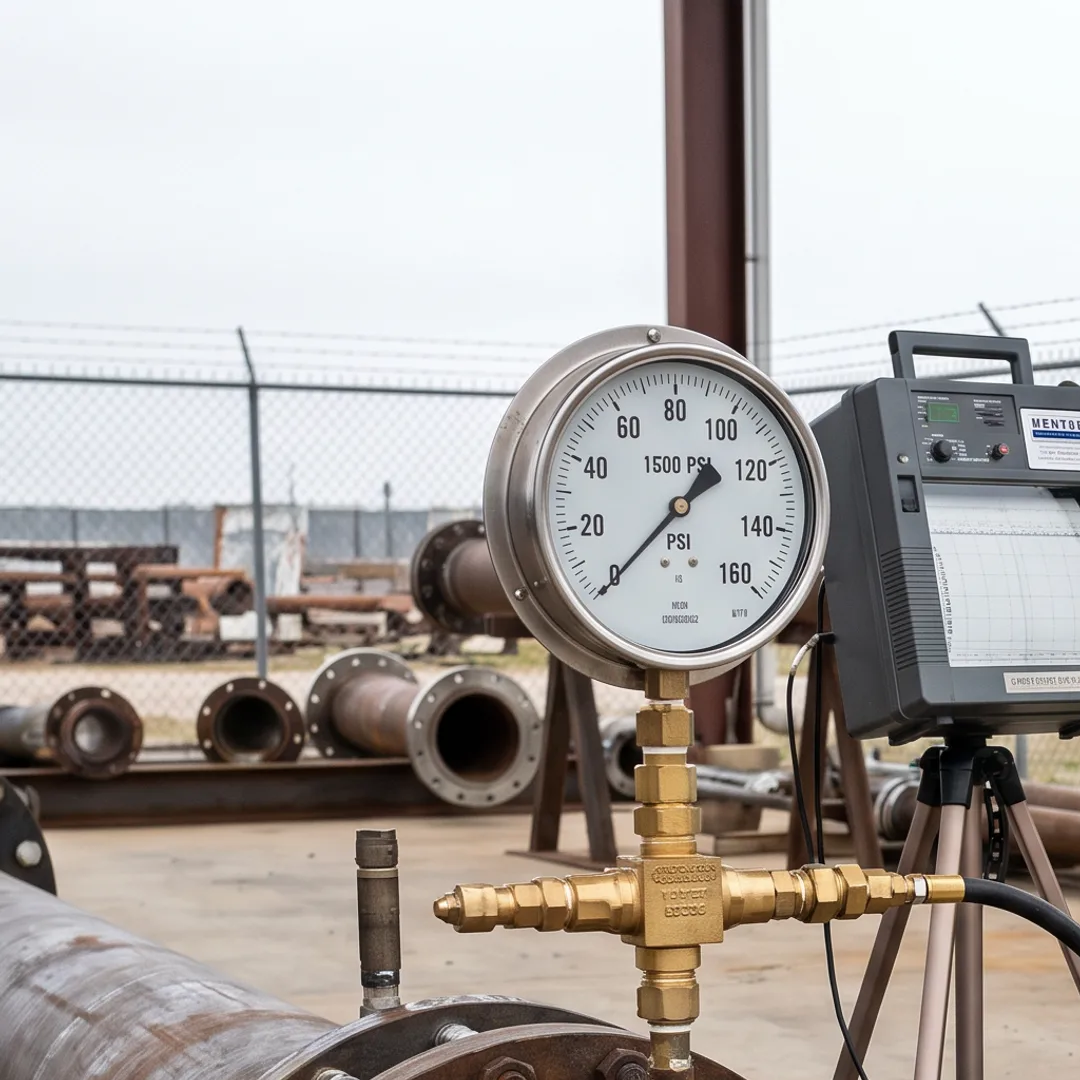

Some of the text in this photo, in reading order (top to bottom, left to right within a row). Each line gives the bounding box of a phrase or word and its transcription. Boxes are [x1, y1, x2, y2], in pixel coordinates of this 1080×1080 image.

[664, 399, 686, 421] 80
[617, 416, 640, 438] 60
[705, 418, 737, 441] 100
[584, 456, 608, 479] 40
[644, 456, 681, 473] 1500
[735, 459, 767, 481] 120
[581, 514, 604, 536] 20
[741, 515, 773, 537] 140
[667, 533, 690, 550] PSI
[610, 564, 620, 586] 0
[720, 562, 751, 584] 160
